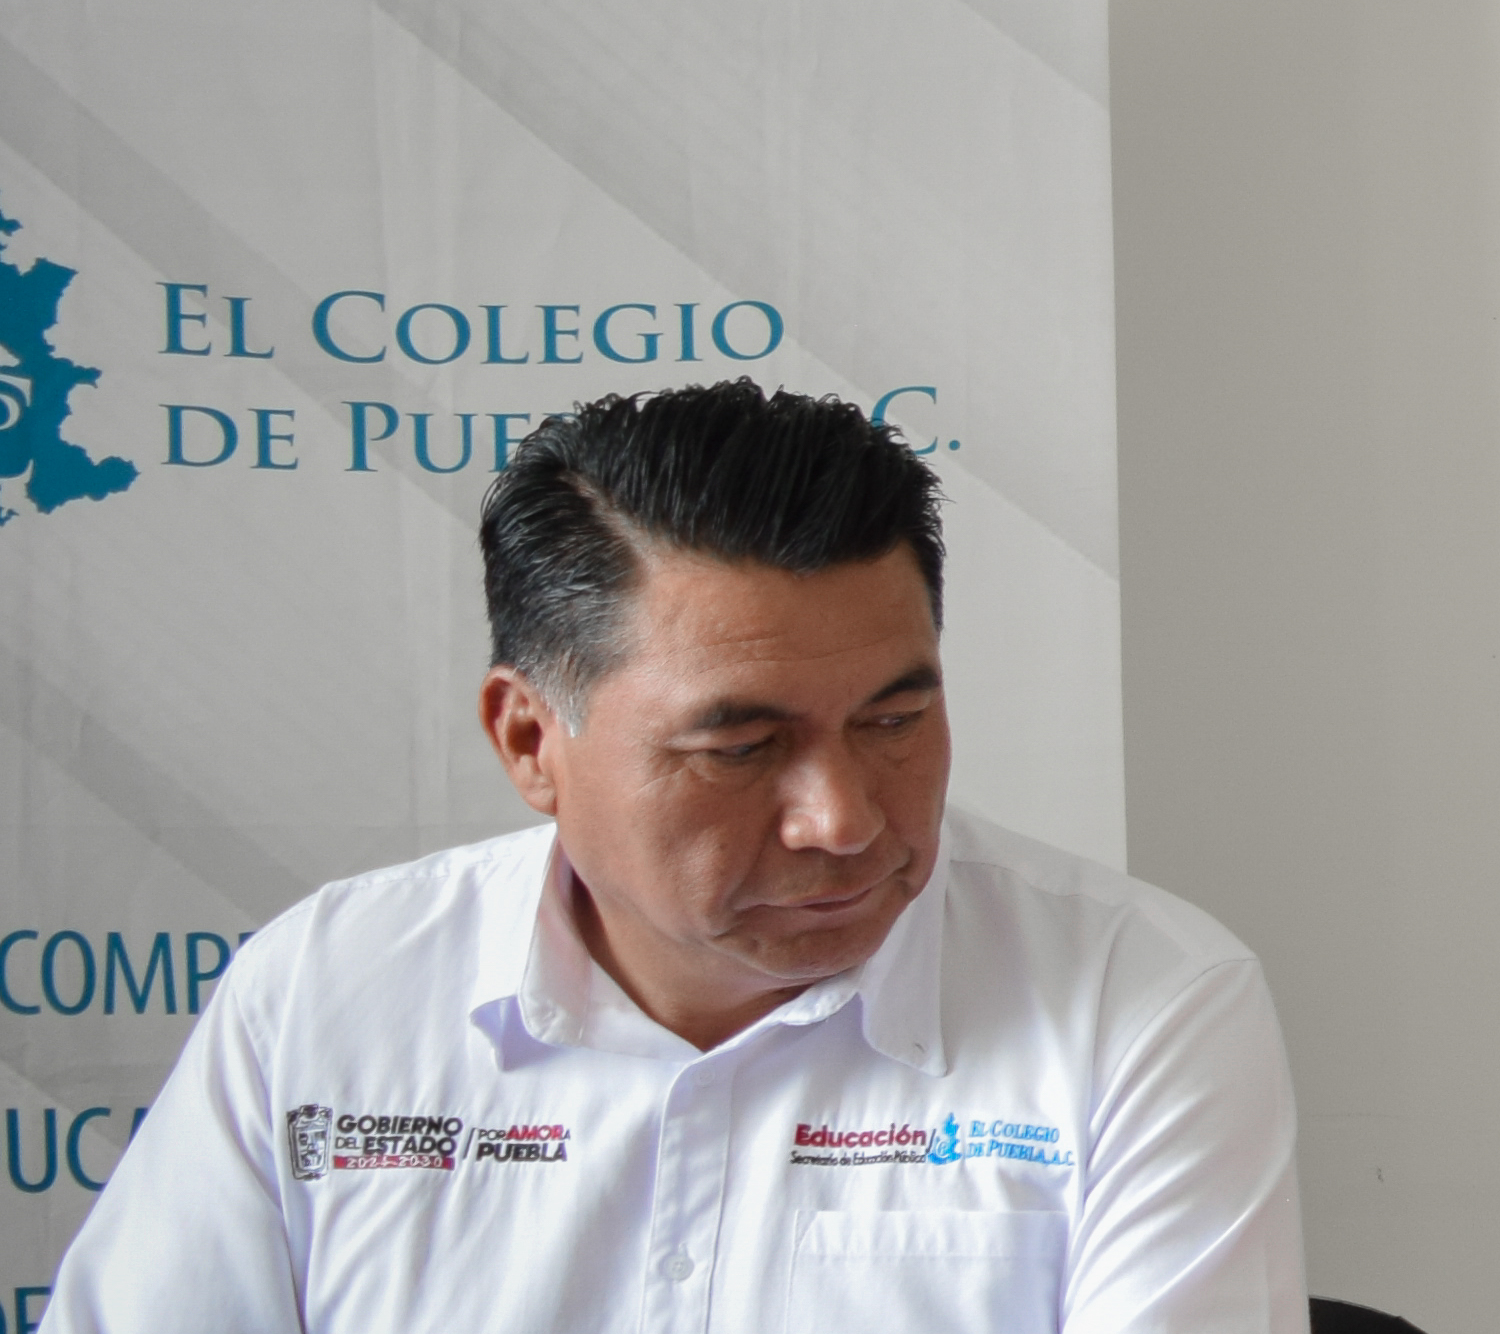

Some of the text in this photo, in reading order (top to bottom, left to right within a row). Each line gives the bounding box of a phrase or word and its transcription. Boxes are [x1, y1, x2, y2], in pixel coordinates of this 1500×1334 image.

[155, 281, 785, 366] EL COLEGIO
[157, 403, 299, 471] DE
[0, 928, 258, 1017] COMP
[336, 1113, 464, 1137] GOBIERNO
[478, 1128, 507, 1142] POR
[506, 1124, 565, 1141] AMOR
[793, 1123, 928, 1149] Educación
[988, 1119, 1060, 1144] COLEGIO
[334, 1135, 458, 1157] DEL ESTADO
[475, 1142, 569, 1164] PUEBLA
